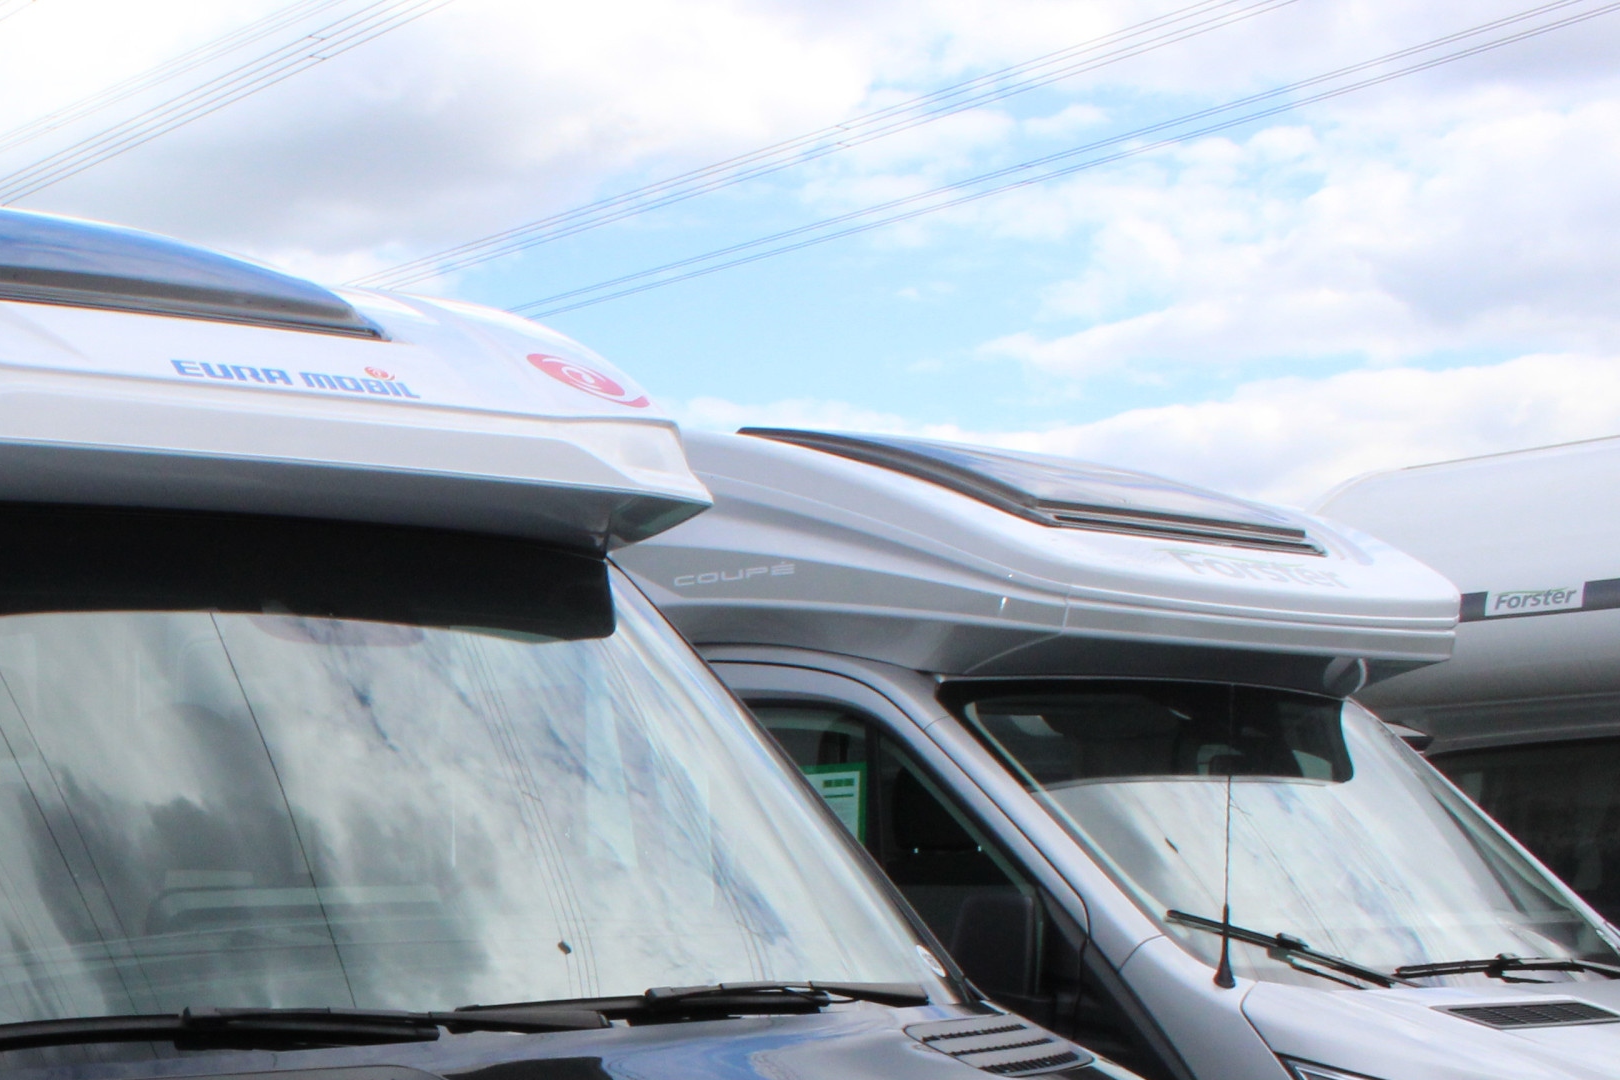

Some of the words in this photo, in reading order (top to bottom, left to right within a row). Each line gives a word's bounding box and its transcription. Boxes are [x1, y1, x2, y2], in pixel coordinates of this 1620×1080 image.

[170, 359, 294, 386] EURA
[299, 371, 421, 399] MOBIL
[673, 561, 796, 587] COUPÉ
[1166, 550, 1350, 589] Forster
[1494, 589, 1577, 611] Forster
